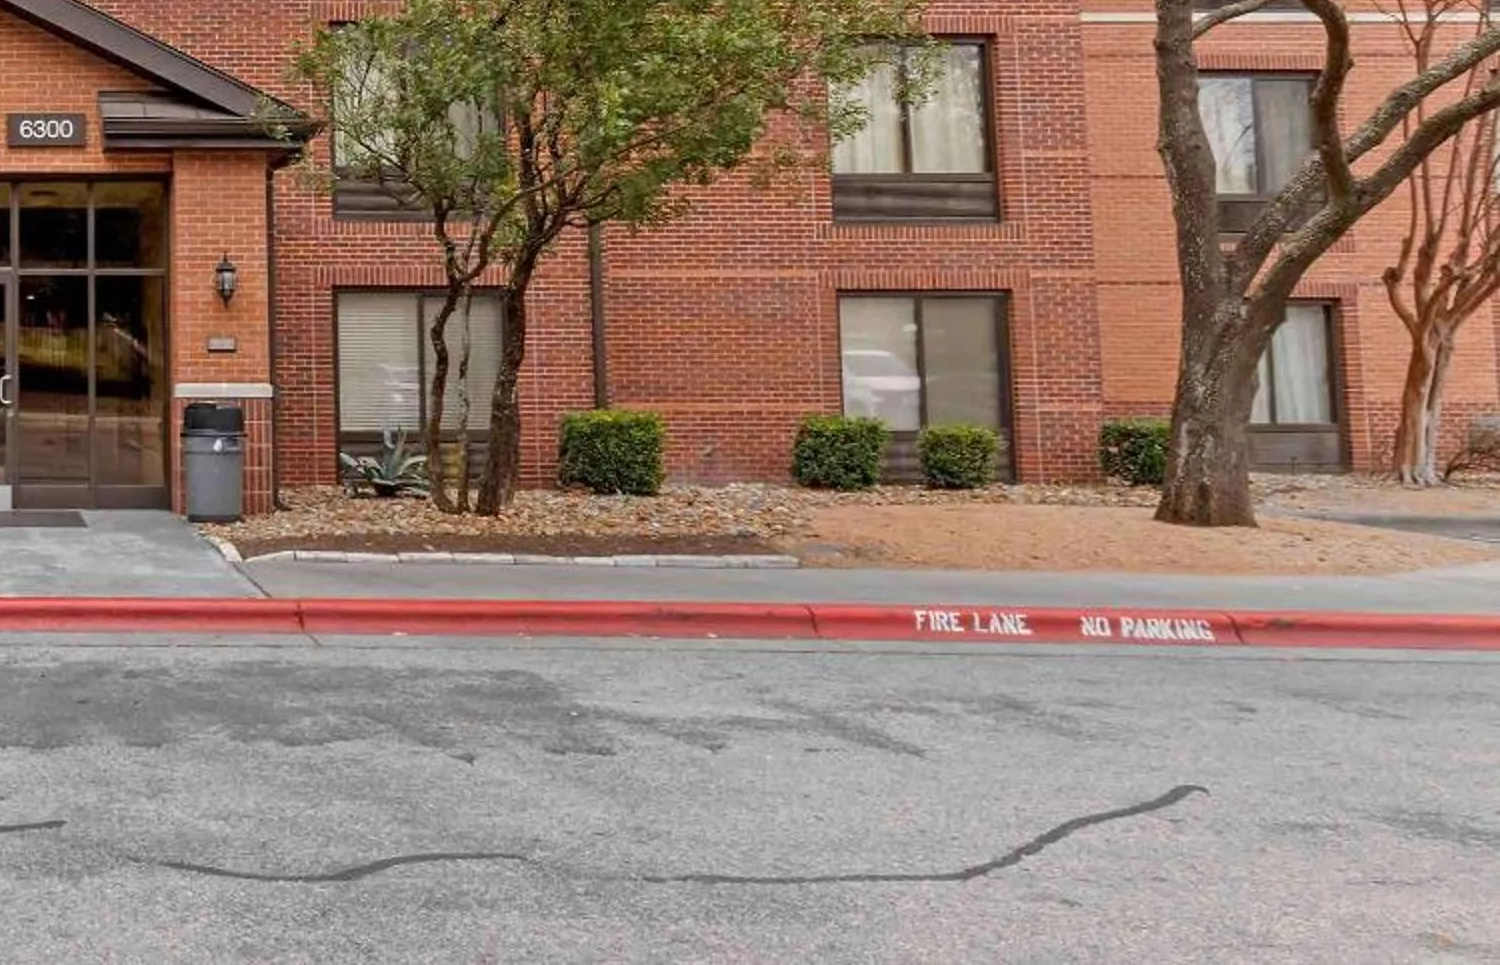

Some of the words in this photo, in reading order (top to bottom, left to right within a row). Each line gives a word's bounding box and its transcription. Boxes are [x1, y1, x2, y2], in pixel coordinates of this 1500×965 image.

[19, 120, 74, 139] 6300
[913, 609, 965, 633] FIRE
[972, 612, 1034, 636] LANE
[1079, 615, 1112, 637] NO
[1119, 616, 1216, 641] PARKING
